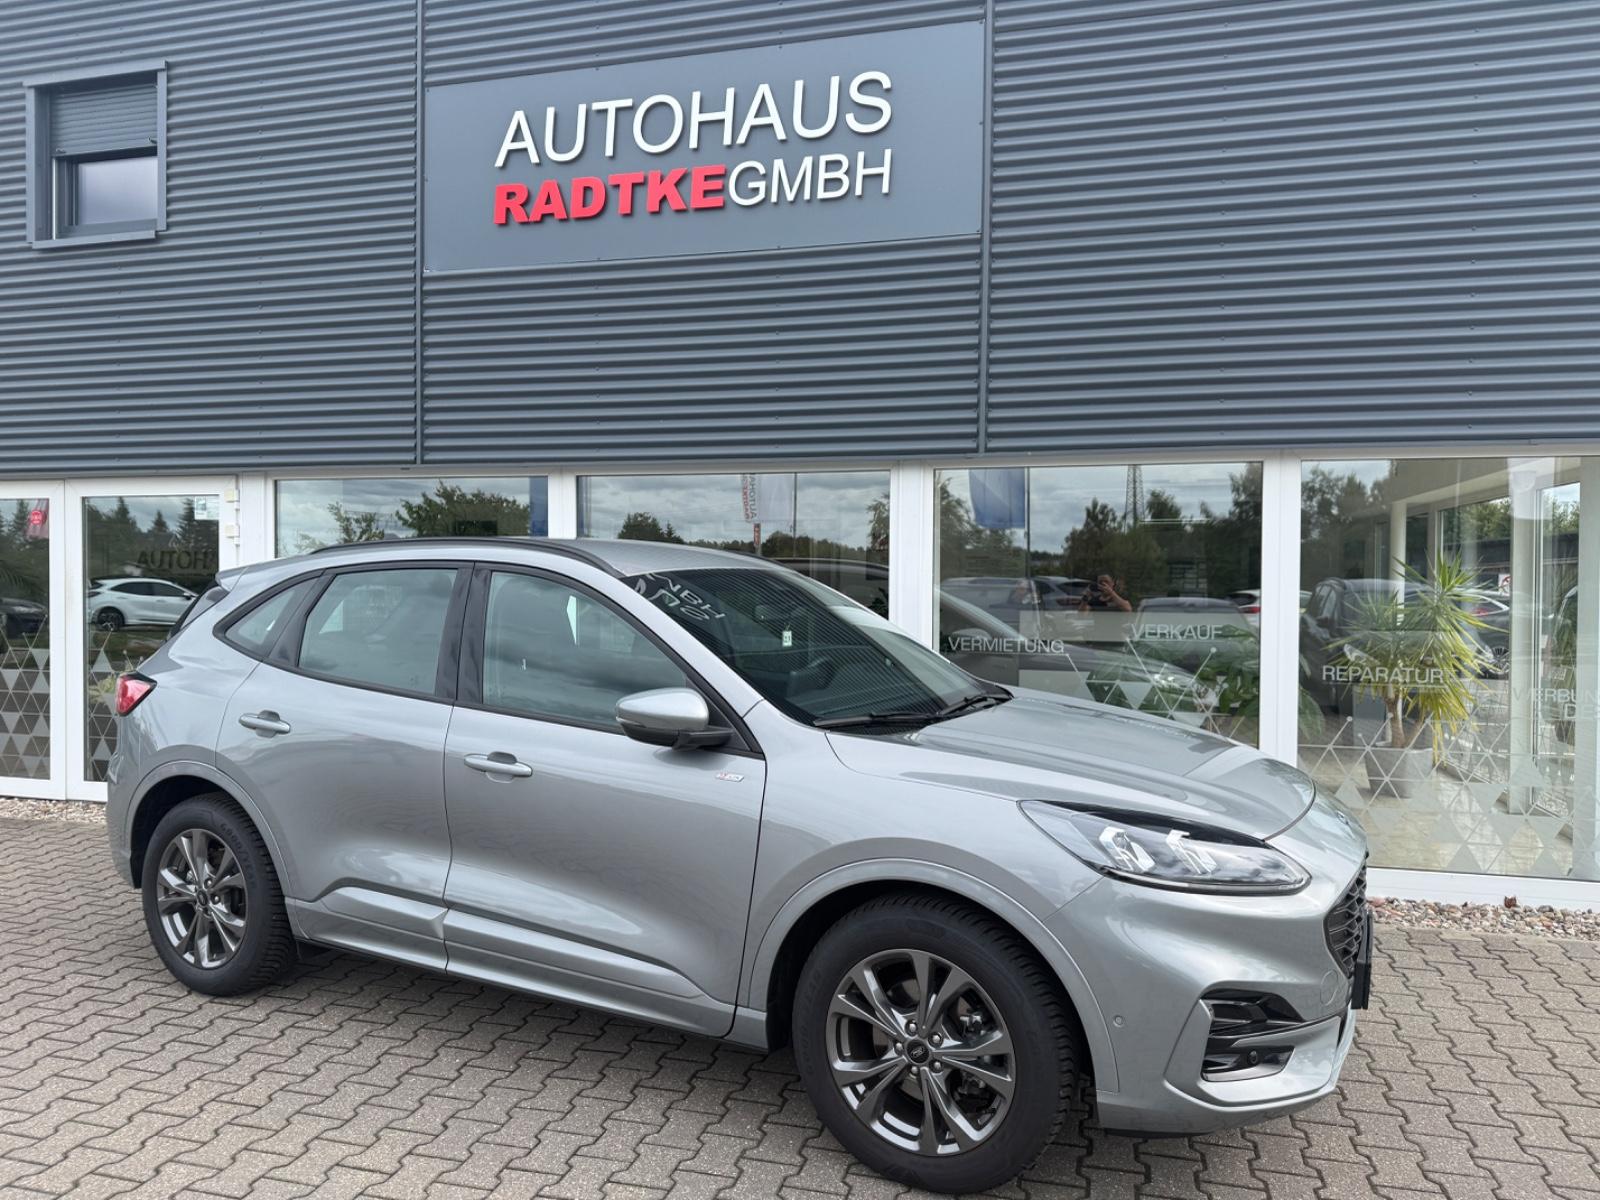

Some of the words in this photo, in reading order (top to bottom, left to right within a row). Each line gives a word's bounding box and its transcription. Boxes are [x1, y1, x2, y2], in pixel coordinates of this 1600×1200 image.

[494, 70, 892, 168] AUTOHAUS
[493, 164, 726, 226] RADTKE
[728, 148, 892, 207] GMBH
[1130, 623, 1223, 641] VERKAUF
[948, 636, 1065, 654] VERMIETUNG
[1322, 664, 1444, 684] REPARATUR
